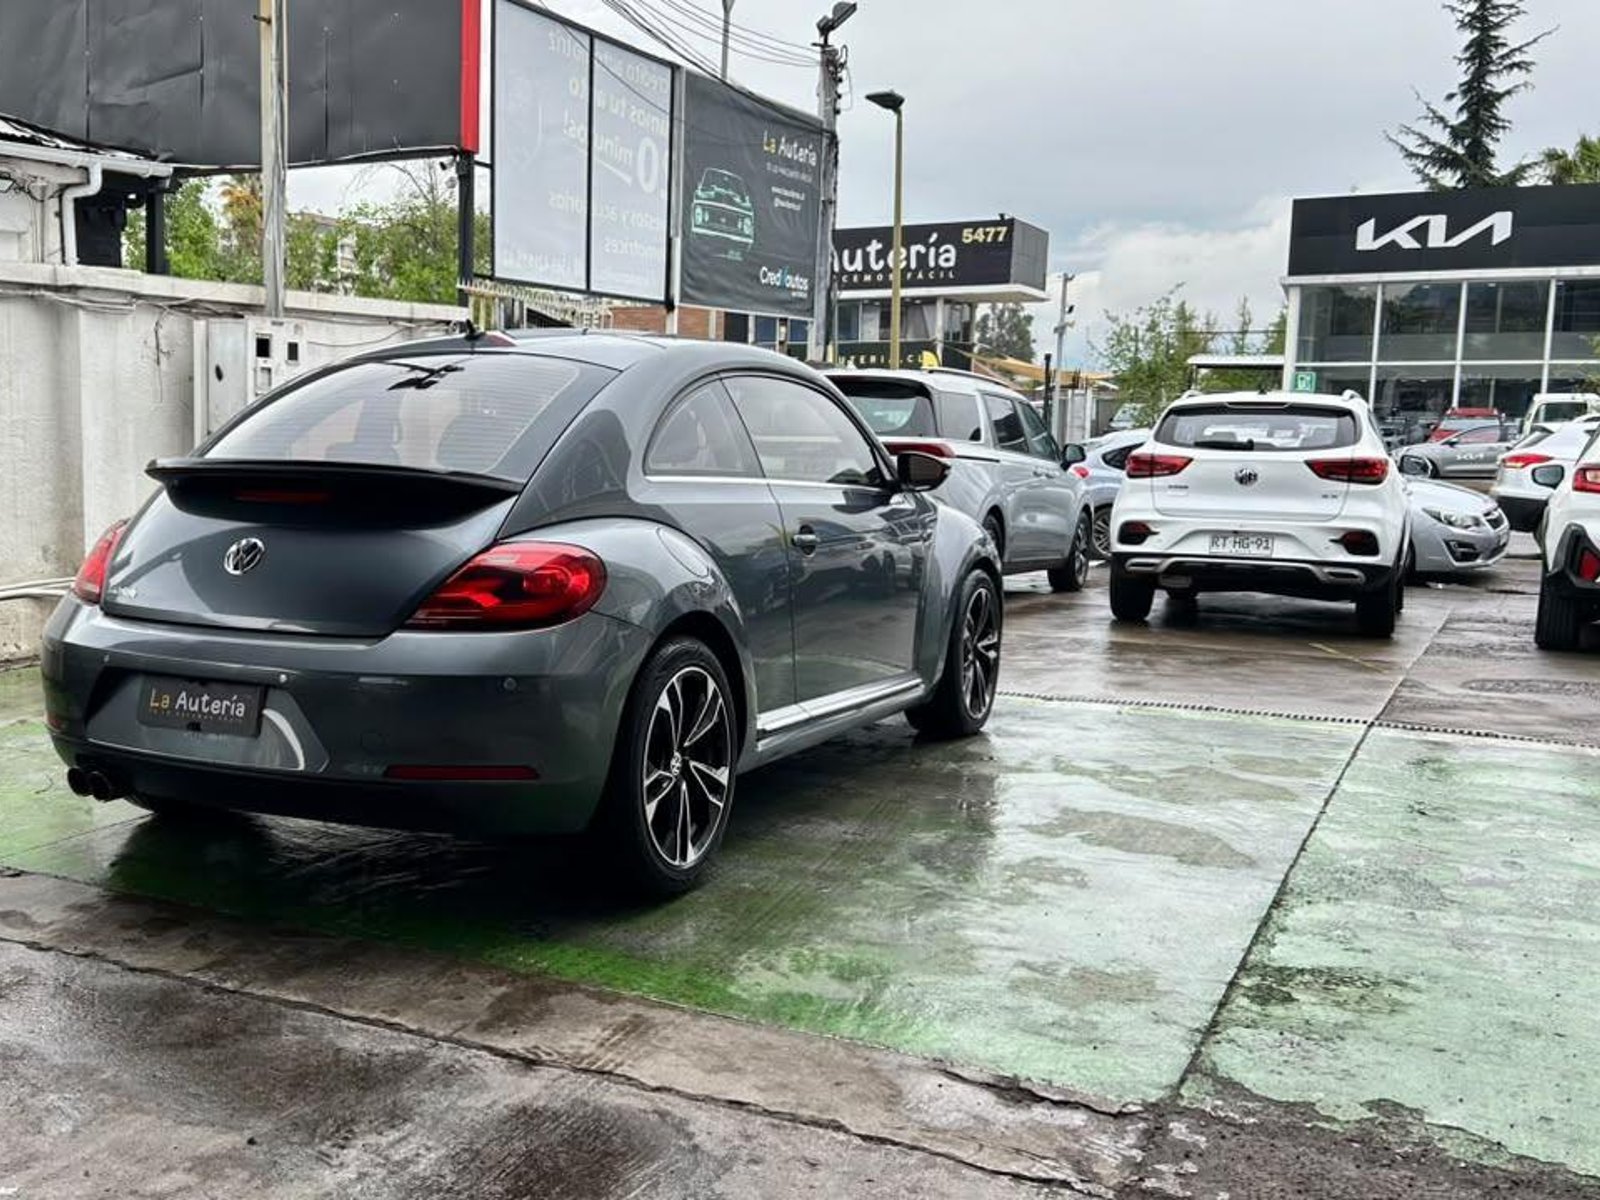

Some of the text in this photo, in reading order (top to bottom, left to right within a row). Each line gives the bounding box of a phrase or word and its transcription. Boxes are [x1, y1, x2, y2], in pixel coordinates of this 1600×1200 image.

[763, 130, 776, 153] La
[962, 226, 1008, 244] 5477
[1356, 211, 1513, 251] KIA
[150, 687, 170, 709] La
[175, 690, 246, 718] Autería
